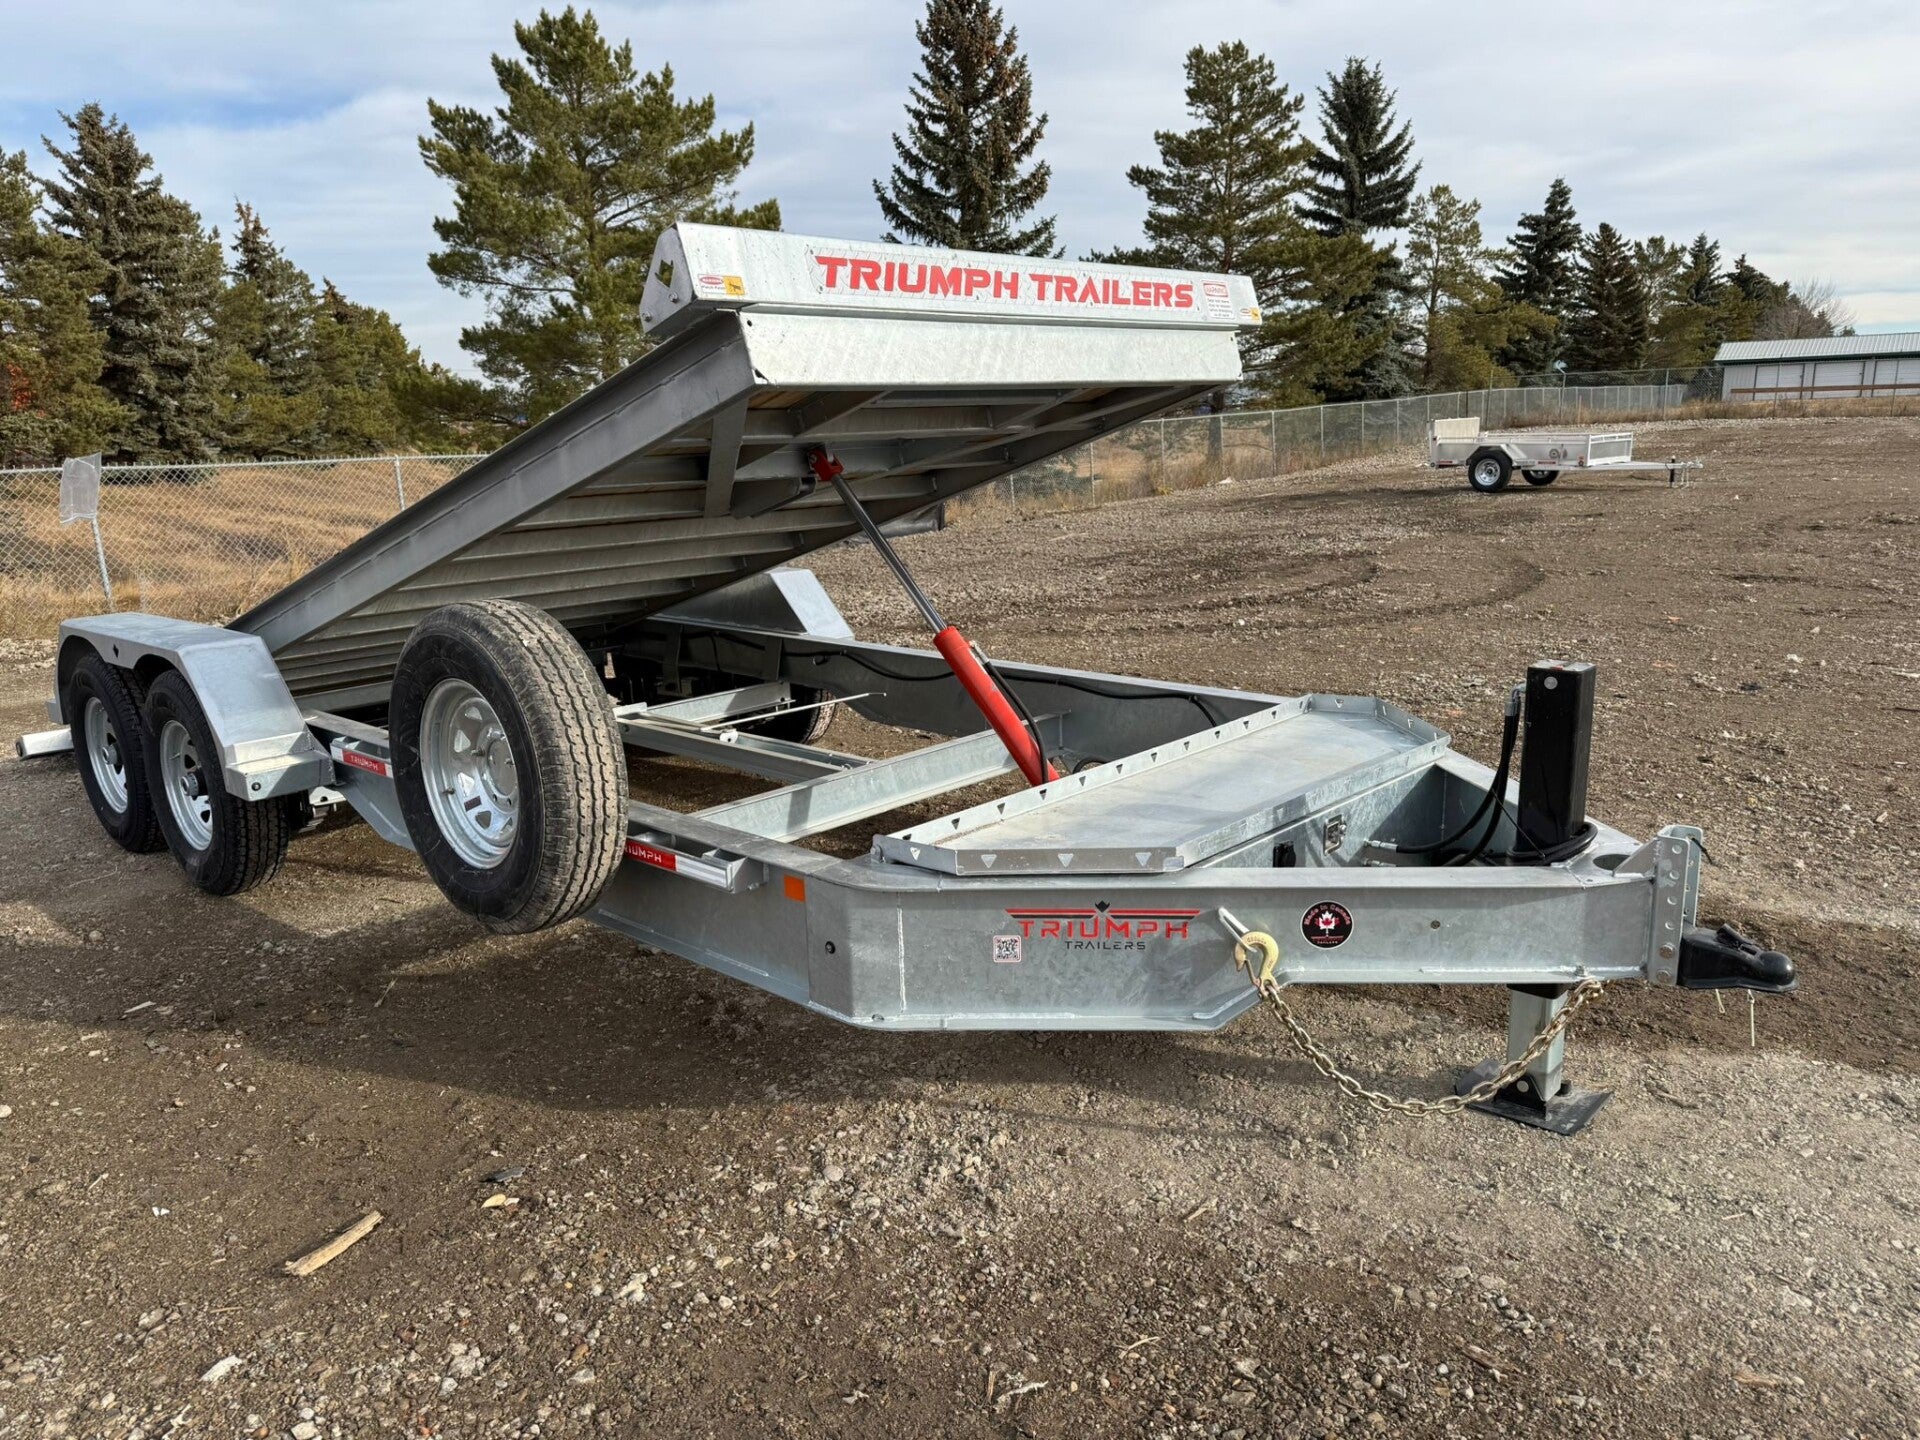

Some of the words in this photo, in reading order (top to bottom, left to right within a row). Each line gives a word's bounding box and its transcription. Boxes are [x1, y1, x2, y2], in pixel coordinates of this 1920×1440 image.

[815, 255, 1018, 299] TRIUMPH
[1029, 273, 1193, 307] TRAILERS
[350, 755, 378, 771] TRIUMPH
[624, 844, 662, 863] RIUMPH
[1018, 917, 1189, 939] TRIUMPH
[1064, 941, 1146, 950] TRAILERS
